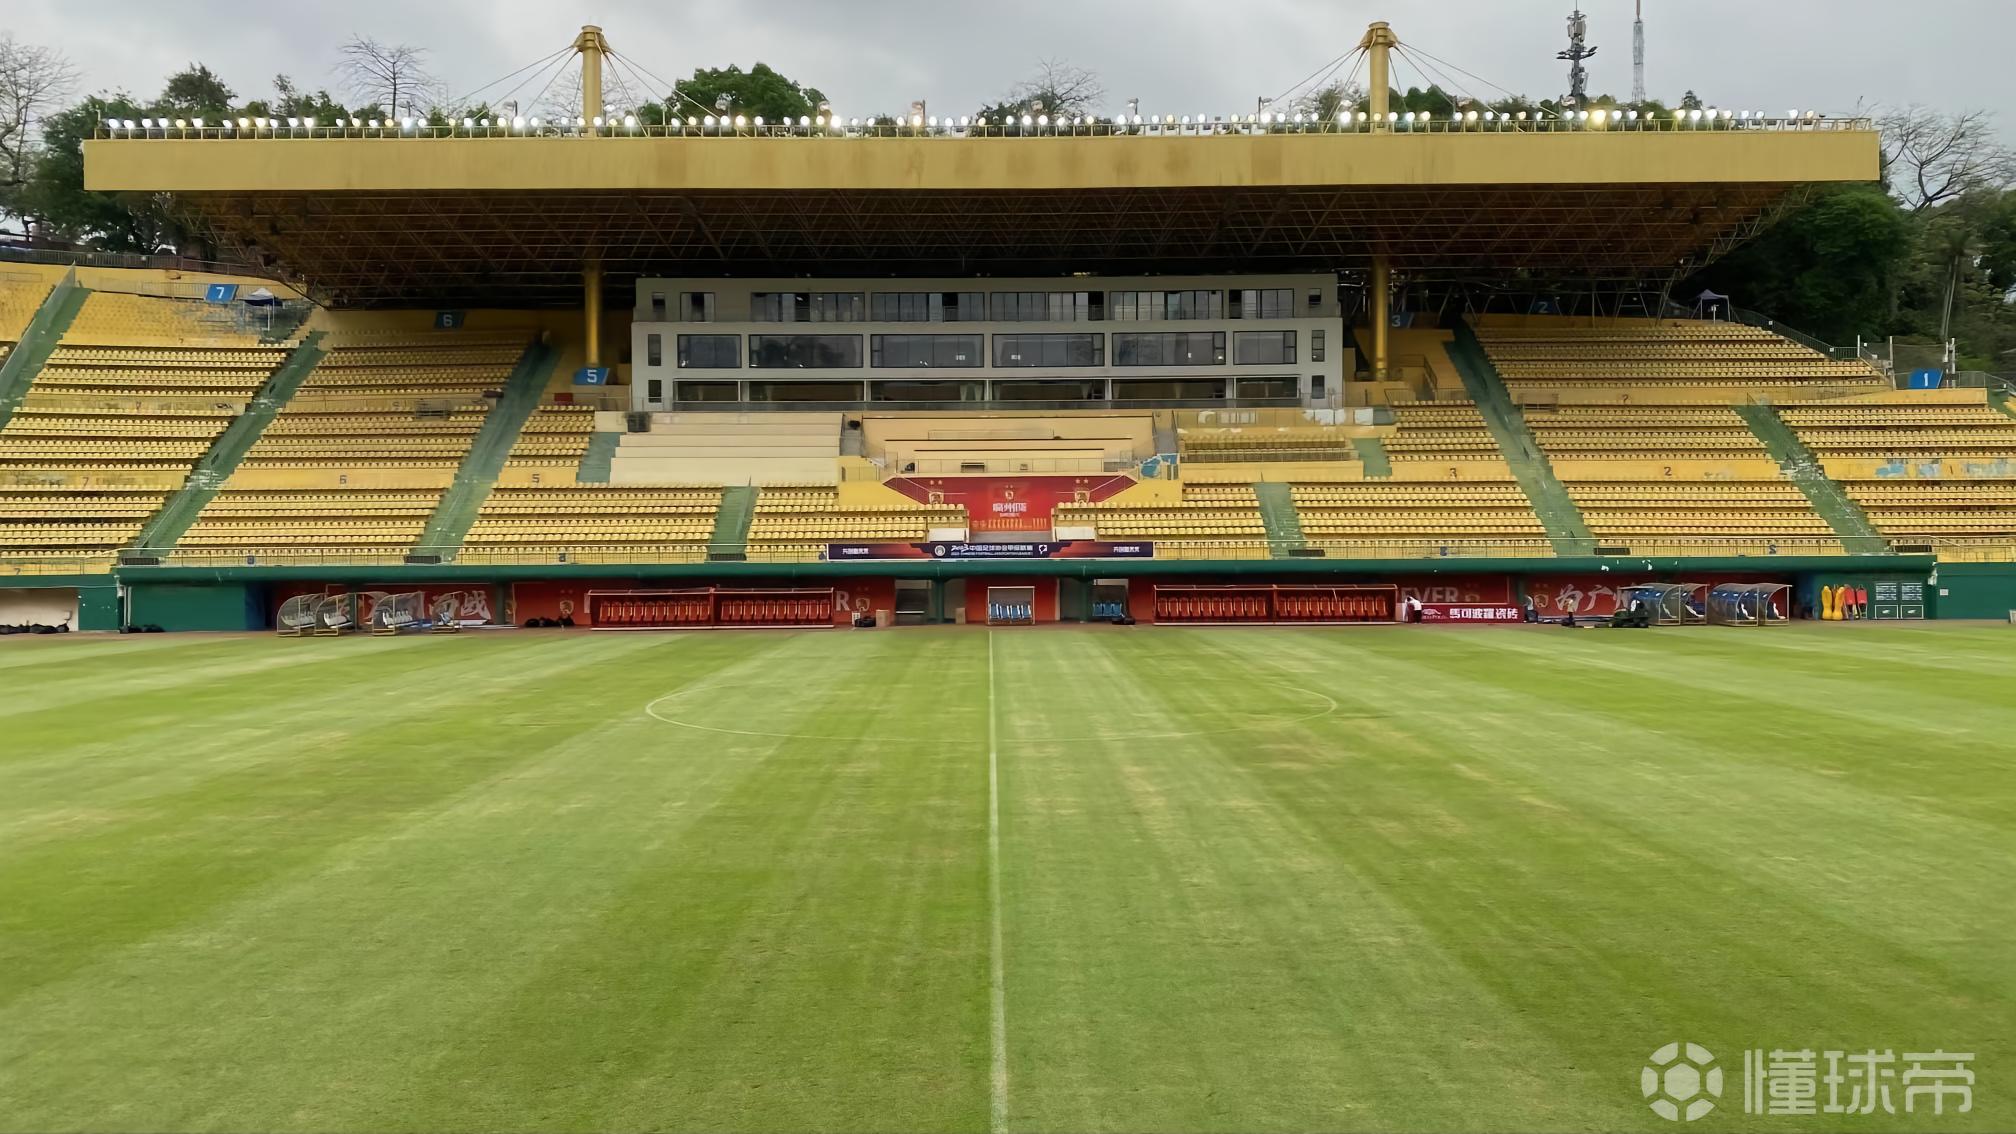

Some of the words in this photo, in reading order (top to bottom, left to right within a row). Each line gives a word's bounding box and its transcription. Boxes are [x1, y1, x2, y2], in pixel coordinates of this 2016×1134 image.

[215, 286, 225, 299] 7
[1538, 301, 1549, 314] 2
[442, 314, 453, 327] 6
[1391, 314, 1401, 328] 3
[586, 369, 598, 383] 5
[1923, 372, 1929, 387] 1
[1663, 466, 1673, 476] 2
[339, 474, 348, 484] 6
[531, 473, 541, 484] 5
